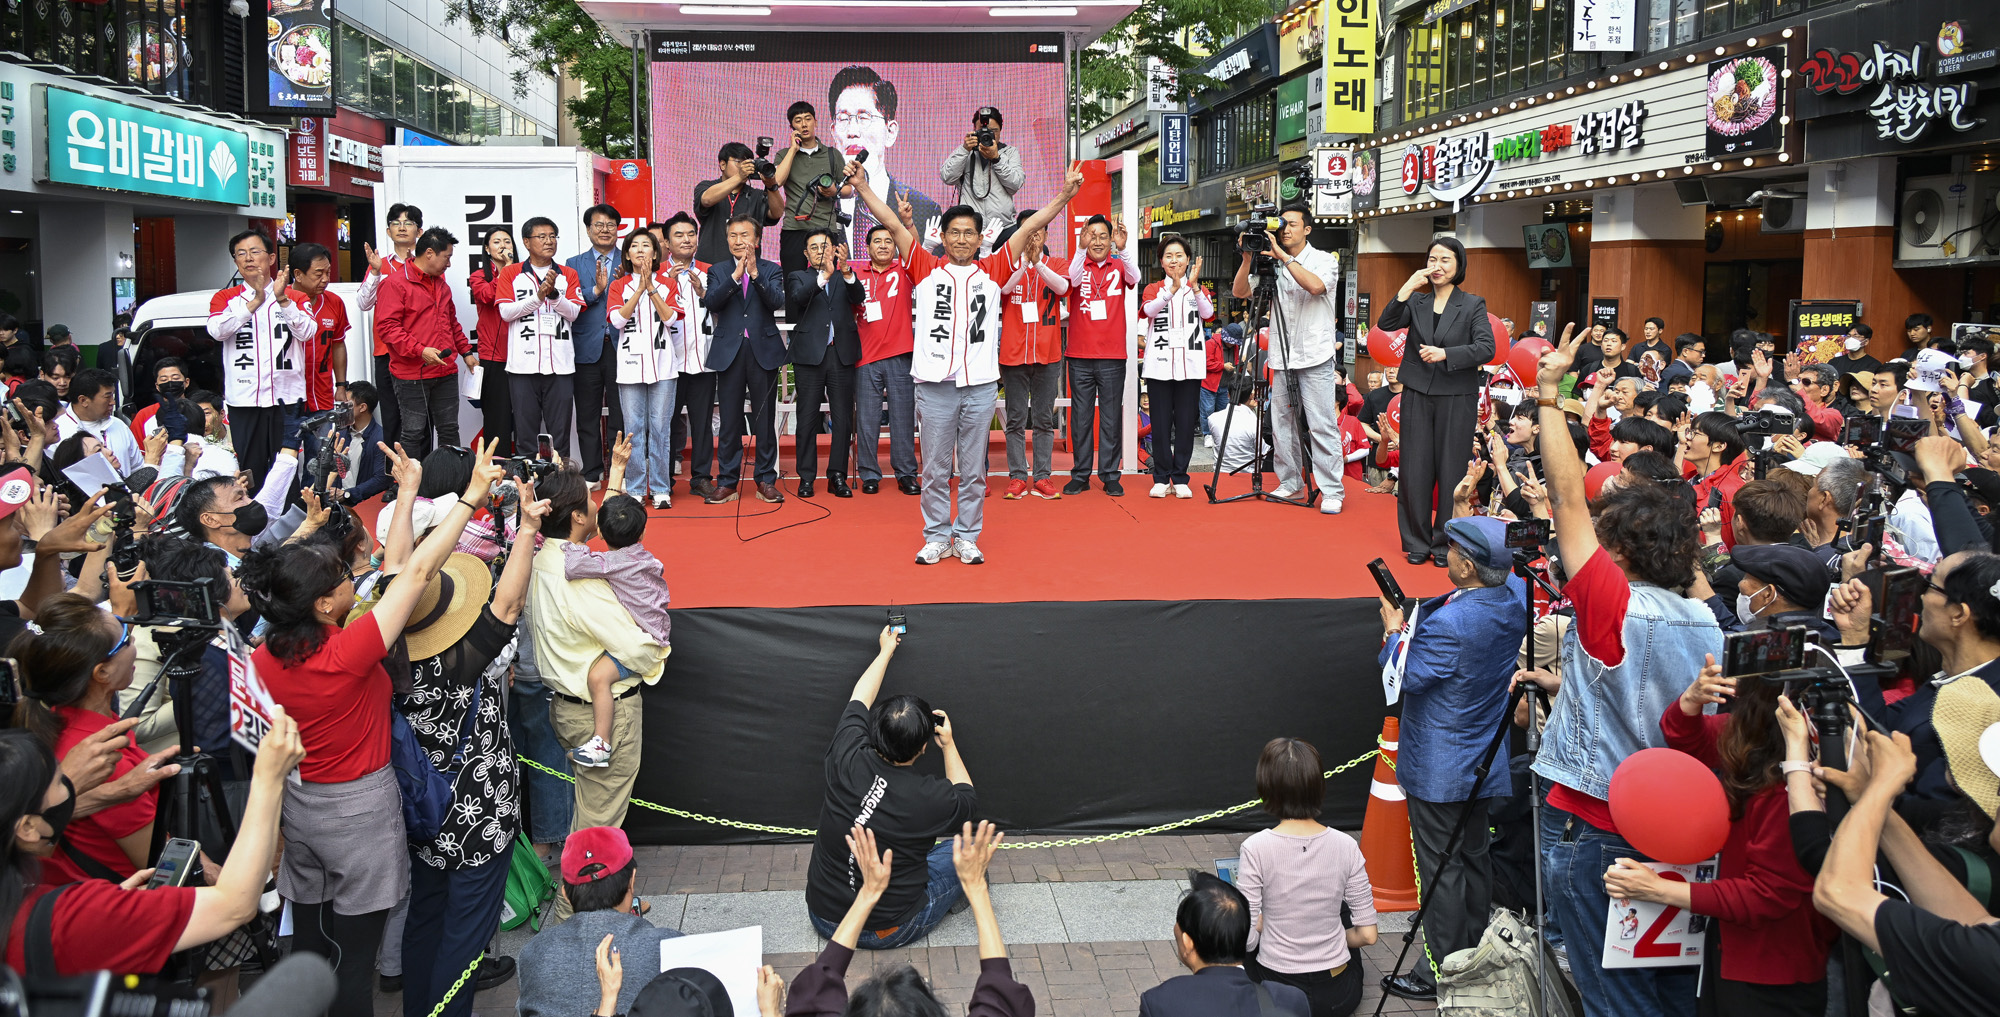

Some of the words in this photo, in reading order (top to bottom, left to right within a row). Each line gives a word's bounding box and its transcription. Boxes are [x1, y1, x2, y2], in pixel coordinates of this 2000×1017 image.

[1938, 57, 1964, 67] KOREAN
[1966, 50, 1995, 62] CHICKEN
[1945, 64, 1960, 72] BEER
[1290, 100, 1304, 118] HAIR
[1870, 83, 1976, 141] 숯불치킨
[1574, 100, 1643, 154] 삼겹살
[298, 146, 316, 156] 보드
[1168, 118, 1182, 164] 계탄언니
[298, 158, 316, 169] 게임
[1330, 158, 1345, 172] 生
[298, 170, 316, 181] 카페
[931, 228, 938, 238] 2
[986, 229, 994, 238] 2
[886, 272, 899, 298] 2
[1106, 268, 1122, 296] 2
[930, 284, 952, 342] 김문수
[1042, 286, 1056, 326] 2
[970, 294, 986, 344] 2
[1188, 310, 1203, 350] 2
[1799, 313, 1852, 328] 얼음생맥주
[274, 323, 293, 370] 2
